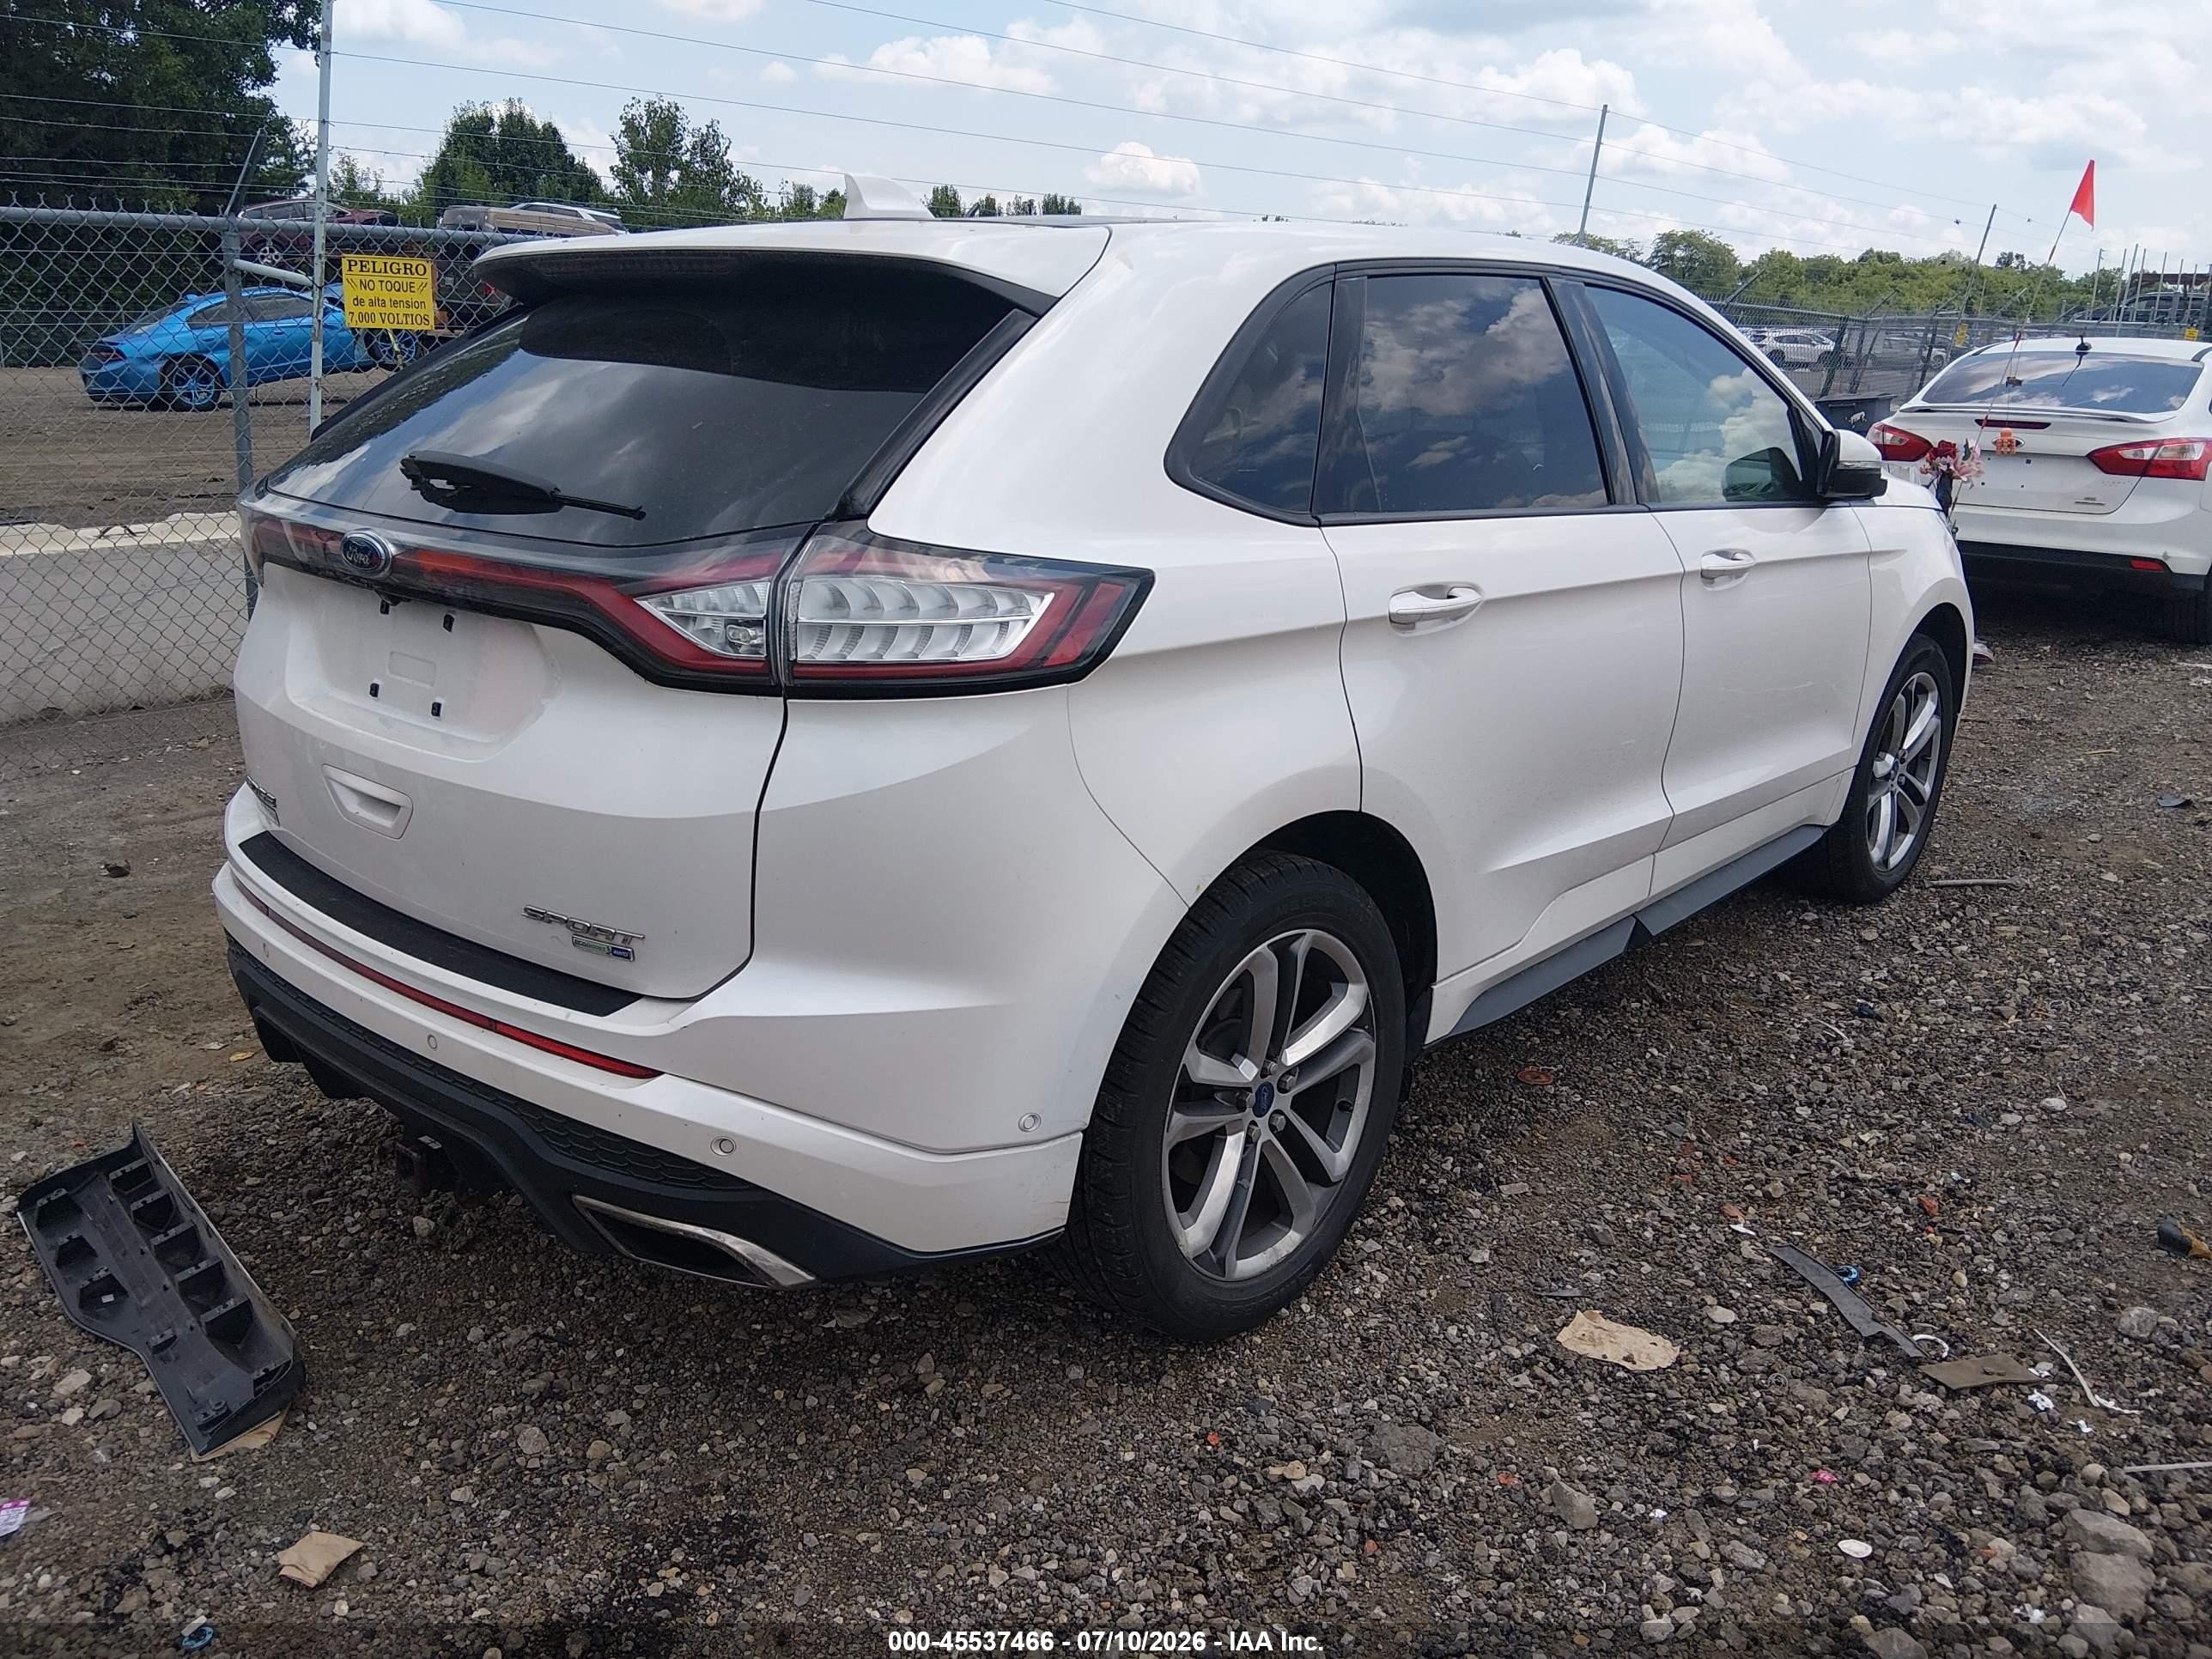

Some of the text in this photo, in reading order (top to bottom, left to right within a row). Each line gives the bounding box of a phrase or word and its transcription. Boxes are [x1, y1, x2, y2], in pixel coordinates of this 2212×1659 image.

[347, 259, 427, 276] PELIGRO
[359, 279, 416, 293] NO TOQUE
[352, 295, 426, 309] de alta tension
[349, 311, 430, 325] 7,000 VOLTIOS
[521, 904, 646, 945] SPORT
